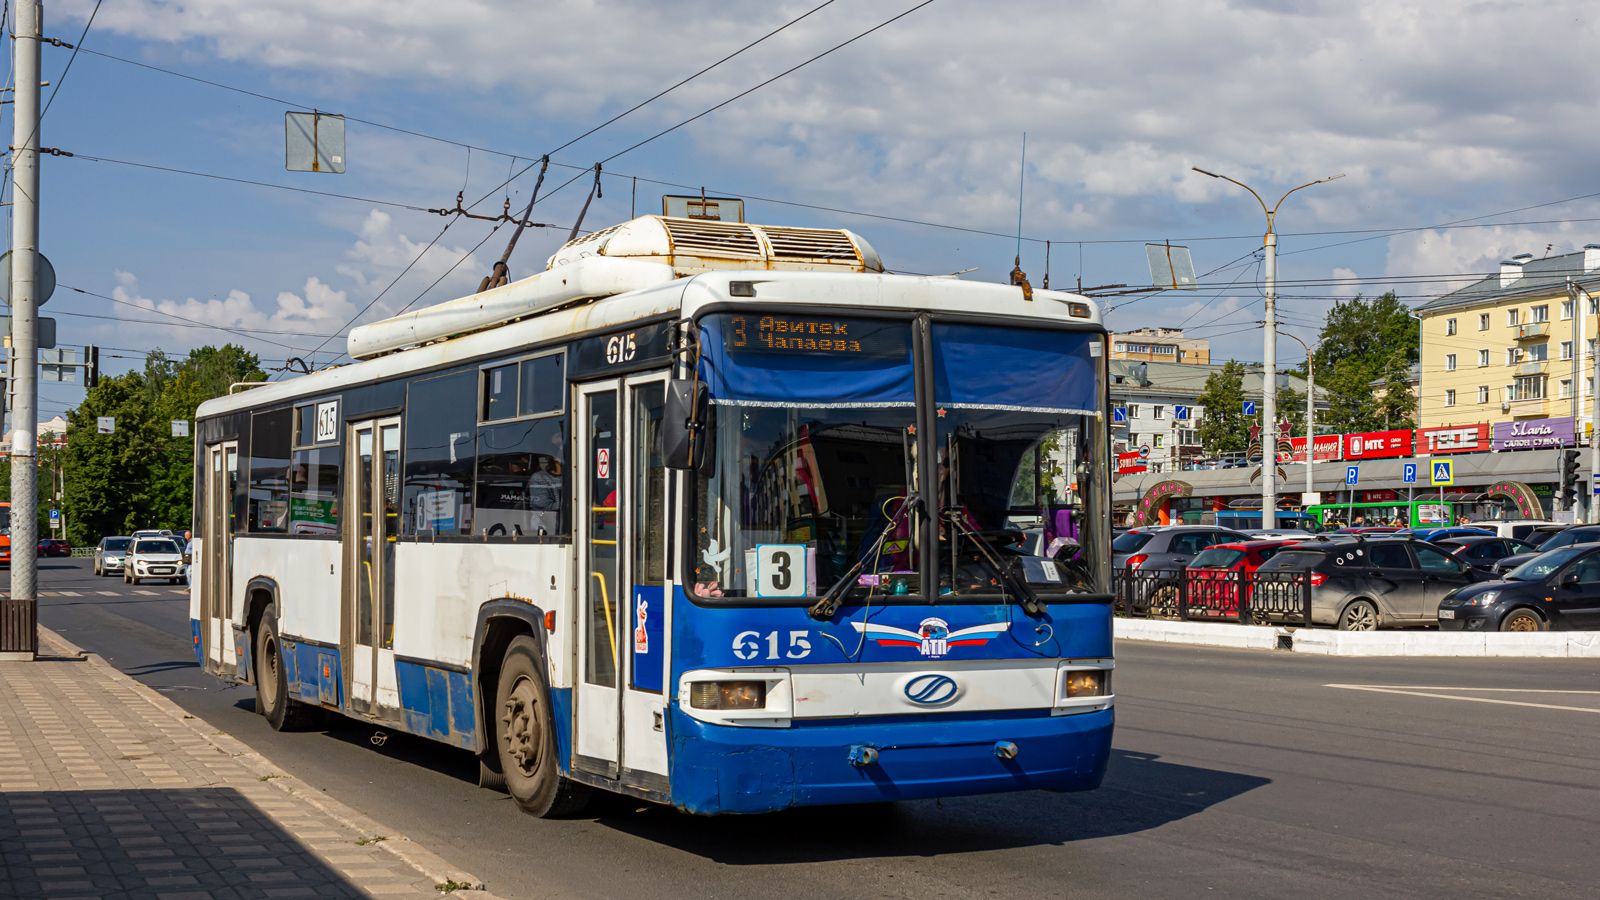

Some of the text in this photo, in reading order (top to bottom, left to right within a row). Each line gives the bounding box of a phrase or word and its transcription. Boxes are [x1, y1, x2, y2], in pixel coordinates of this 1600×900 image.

[731, 316, 747, 347] 3
[759, 316, 848, 335] Авитек
[606, 332, 636, 364] 615
[758, 332, 862, 351] Чапаева
[318, 406, 336, 437] 615
[1511, 421, 1554, 437] S.Lavia
[1294, 441, 1338, 454] ШАМАНИЯ
[1364, 438, 1384, 451] МТС
[1424, 428, 1479, 451] ТВОЕ
[1503, 437, 1561, 448] САЛОН СУМОК
[771, 551, 792, 591] 3
[732, 630, 812, 660] 615
[920, 639, 948, 655] АТП
